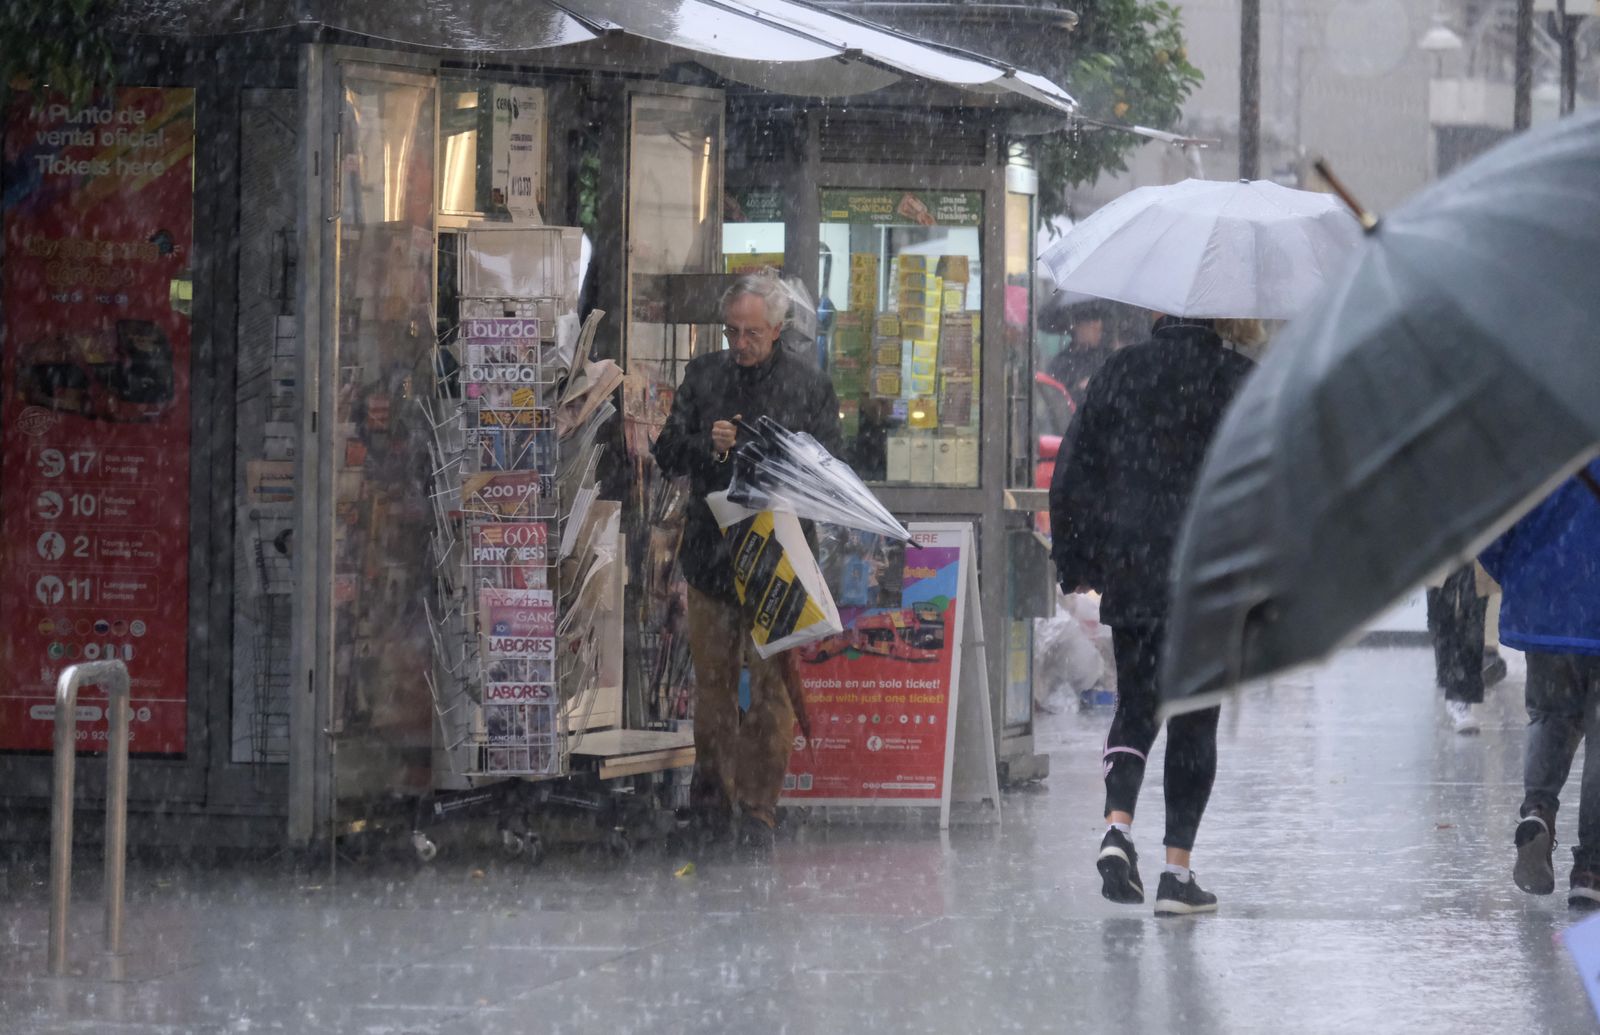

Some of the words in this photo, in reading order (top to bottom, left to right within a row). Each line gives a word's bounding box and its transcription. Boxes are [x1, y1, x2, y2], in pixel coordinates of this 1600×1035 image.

[49, 103, 113, 123] Punto
[119, 106, 146, 124] de
[35, 128, 95, 146] venta
[100, 127, 164, 147] oficial
[34, 154, 111, 176] Tickets
[116, 156, 165, 177] here
[473, 319, 537, 338] burda
[470, 364, 535, 382] burda
[69, 452, 97, 474] 17
[483, 485, 514, 498] 200
[68, 493, 97, 516] 10
[72, 535, 90, 558] 2
[66, 577, 92, 601] 11
[488, 638, 552, 653] LABORES
[485, 685, 550, 700] LABORES
[802, 678, 842, 689] órdoba
[845, 680, 859, 689] en
[862, 680, 876, 689] un
[879, 678, 902, 689] solo
[905, 678, 941, 689] ticket!
[835, 693, 858, 703] with
[860, 693, 882, 705] just
[885, 694, 905, 704] one
[909, 693, 945, 704] ticket!
